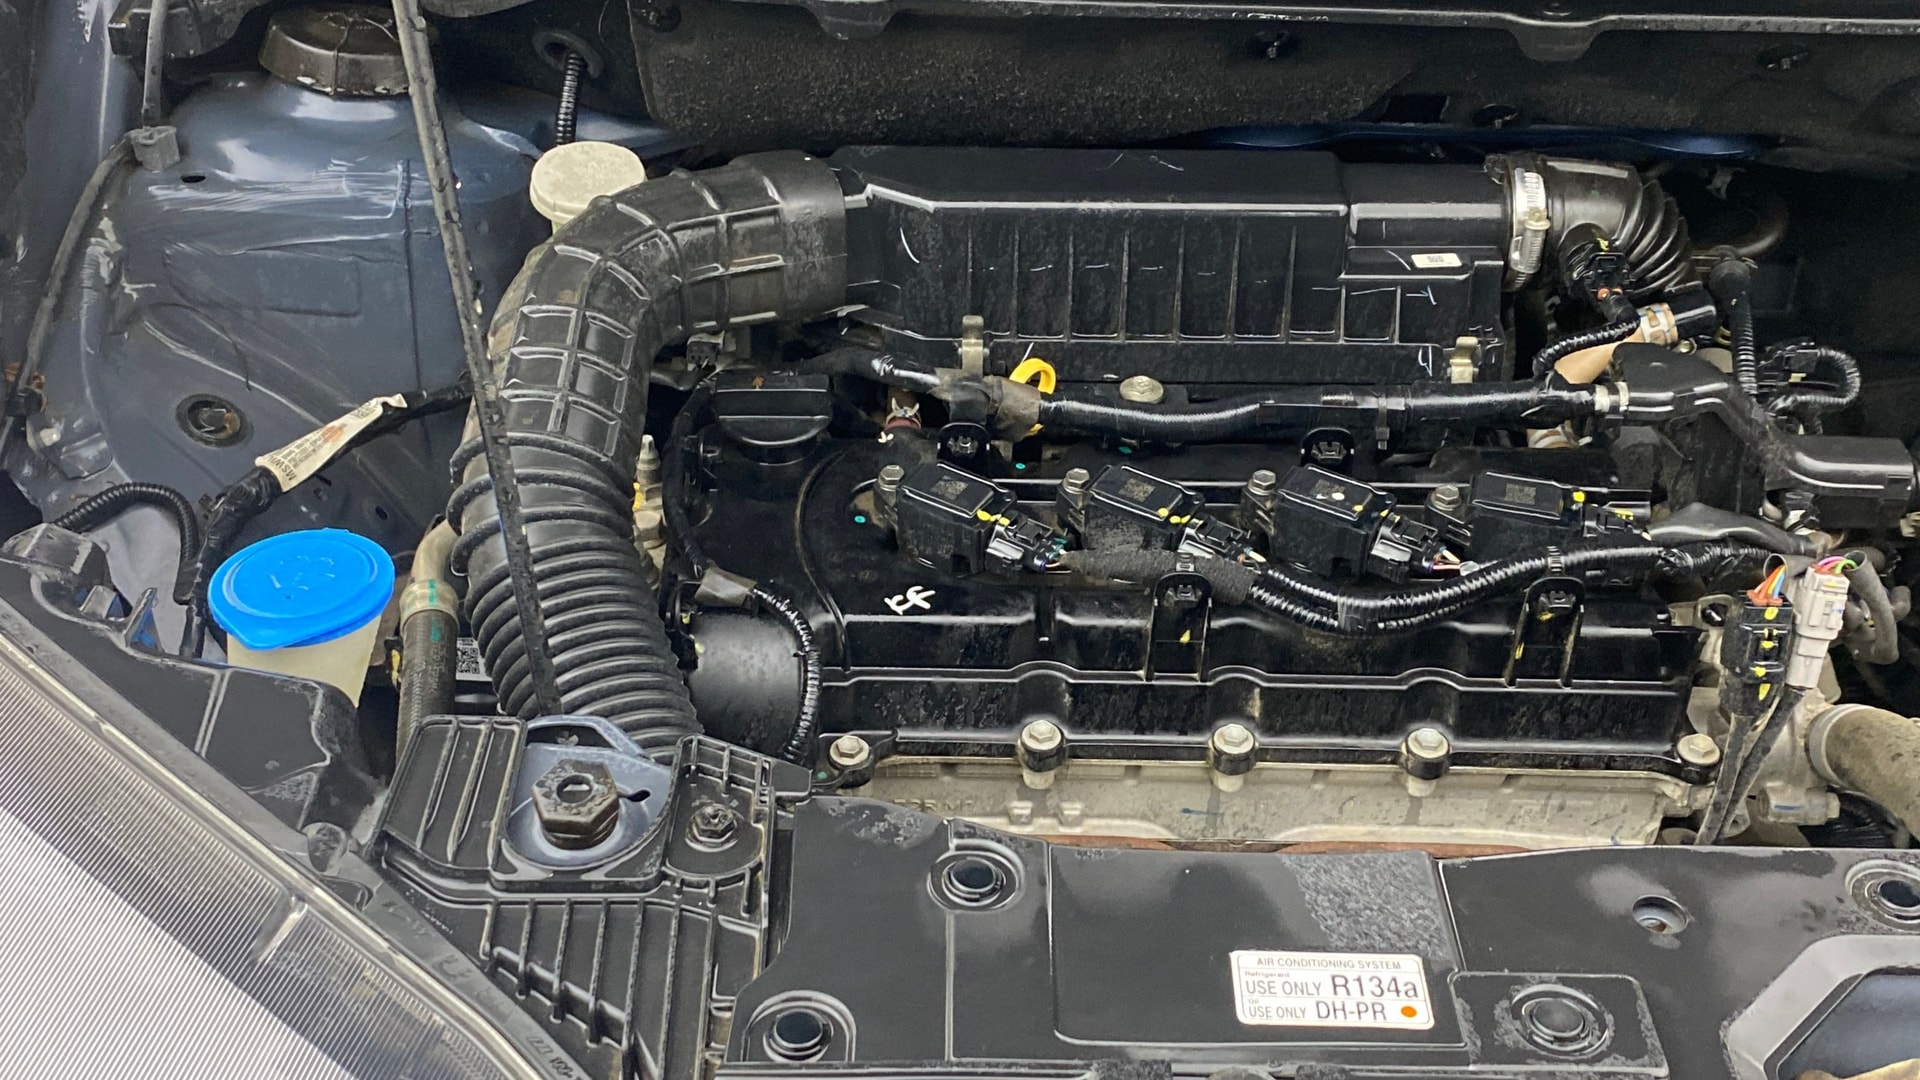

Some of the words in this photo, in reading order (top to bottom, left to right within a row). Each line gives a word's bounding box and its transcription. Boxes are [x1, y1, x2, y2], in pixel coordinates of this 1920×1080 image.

[1257, 957, 1274, 967] AIR
[1278, 957, 1355, 969] CONDITIONING
[1358, 960, 1402, 970] SYSTEM
[1245, 980, 1277, 995] USE
[1281, 980, 1322, 996] ONLY
[1331, 974, 1419, 998] R134a
[1249, 1005, 1272, 1018] USE
[1276, 1006, 1307, 1018] ONLY
[1316, 1000, 1387, 1021] DH-PR
